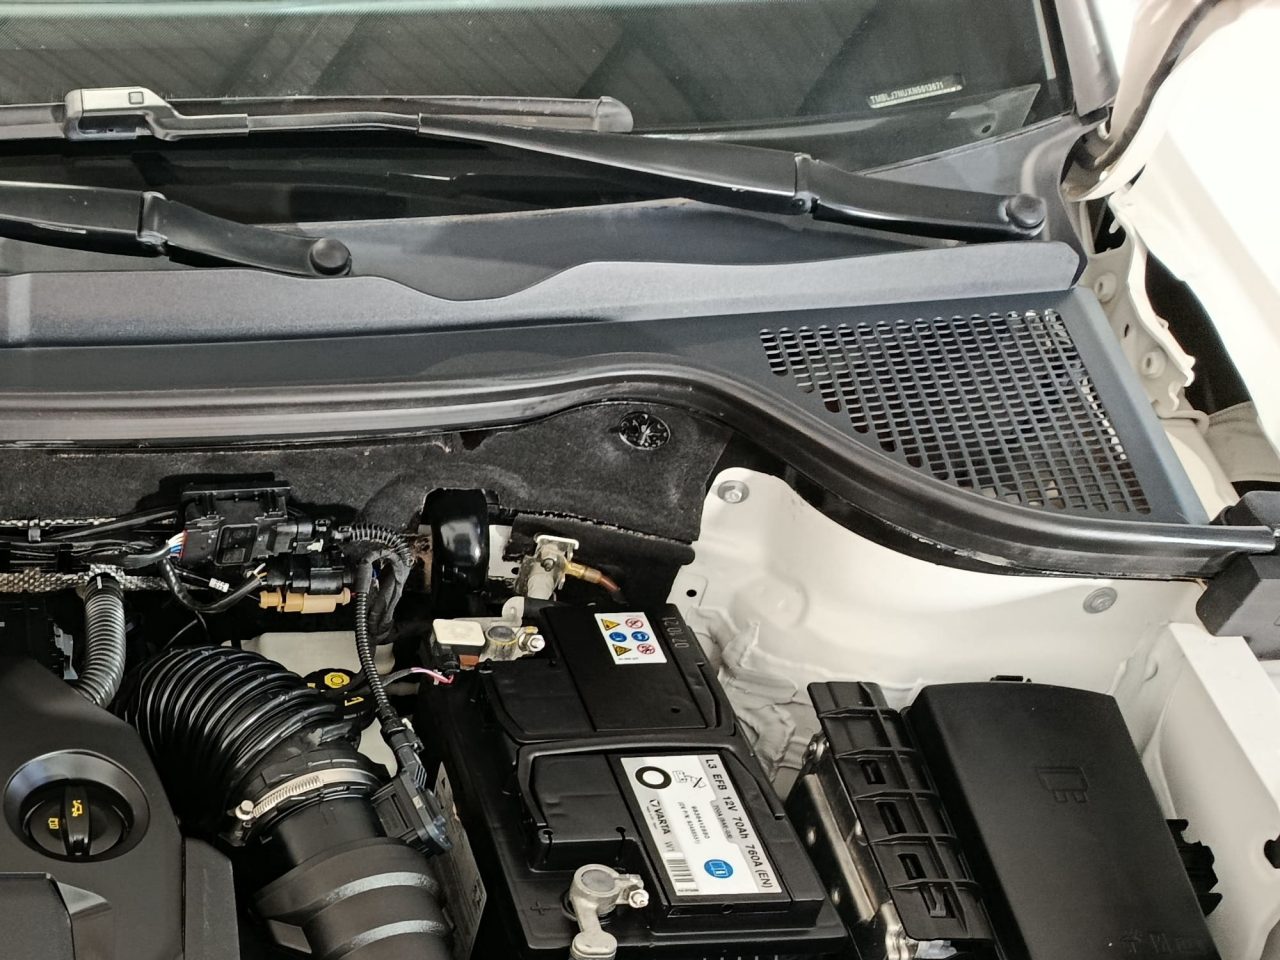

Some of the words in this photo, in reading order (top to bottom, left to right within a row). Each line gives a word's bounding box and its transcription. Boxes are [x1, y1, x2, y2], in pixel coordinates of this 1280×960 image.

[654, 805, 671, 835] VARTA
[705, 758, 718, 770] L3
[712, 773, 728, 791] EFB
[723, 796, 738, 812] 12V
[732, 816, 749, 839] 70Ah
[745, 844, 763, 867] 760A
[755, 869, 773, 889] (EN)
